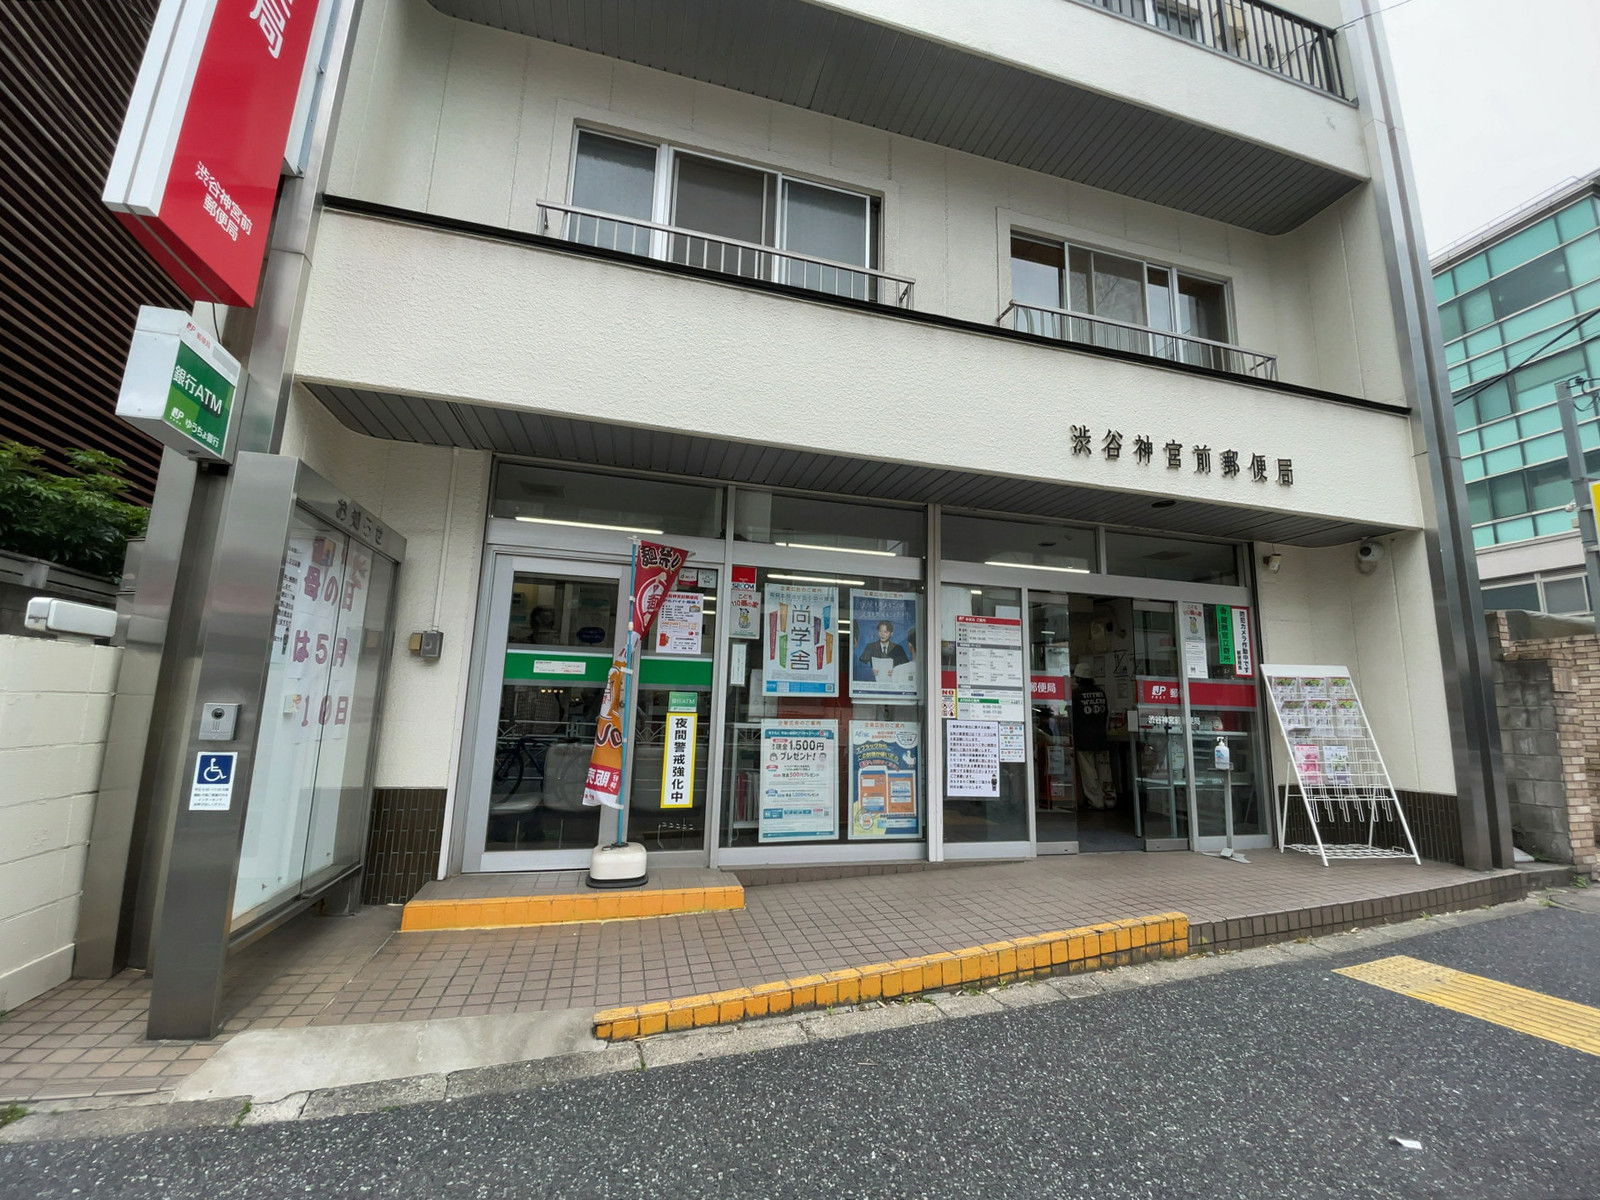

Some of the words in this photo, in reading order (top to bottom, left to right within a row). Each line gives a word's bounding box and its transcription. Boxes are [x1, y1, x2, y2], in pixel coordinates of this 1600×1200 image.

[249, 0, 292, 59] 局
[195, 160, 252, 235] 渋谷神宮前
[202, 194, 239, 241] 郵便局
[172, 364, 223, 415] 銀行ATM
[185, 417, 220, 448] ゆうちょ銀行
[1071, 424, 1294, 486] 渋谷神宮前郵便局
[335, 498, 384, 546] お知らせ
[304, 565, 359, 612] 母の日
[731, 600, 759, 608] 110番の家
[1239, 611, 1249, 673] 防犯カメラ作動中です
[671, 717, 688, 802] 夜間警戒強化中
